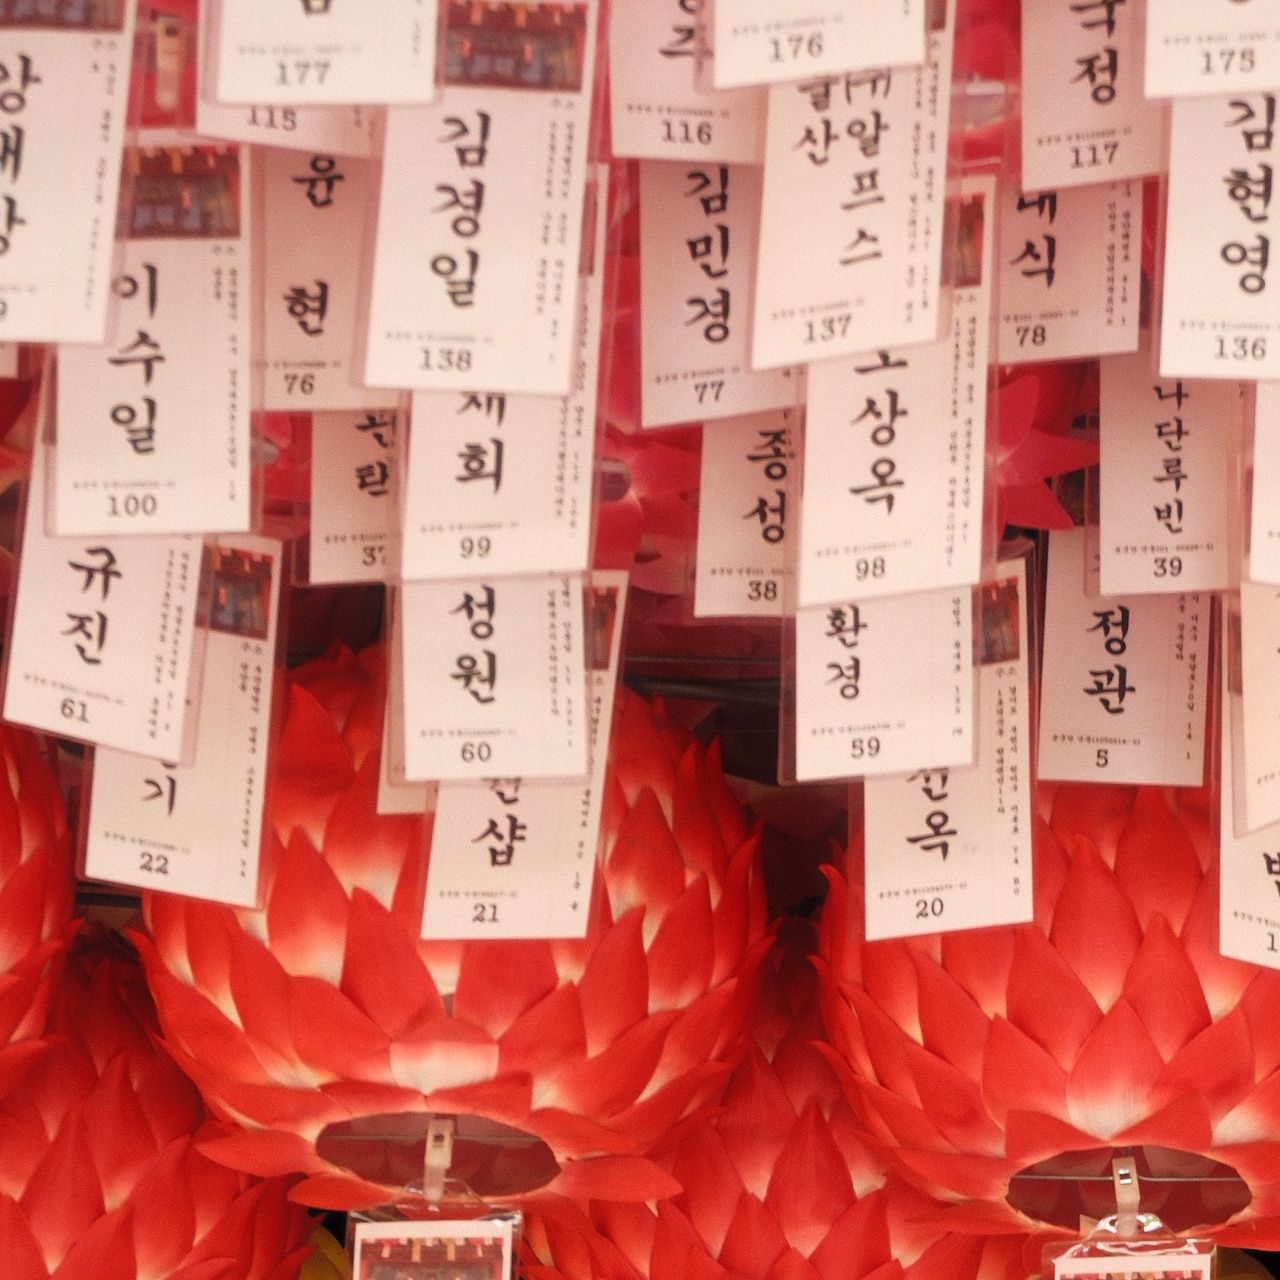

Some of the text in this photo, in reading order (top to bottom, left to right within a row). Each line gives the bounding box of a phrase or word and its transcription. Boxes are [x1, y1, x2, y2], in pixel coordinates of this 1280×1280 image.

[769, 34, 824, 63] 176
[276, 61, 331, 86] 177
[1202, 49, 1255, 75] 175
[248, 104, 297, 132] 115
[661, 119, 713, 145] 116
[1071, 142, 1119, 169] 117
[803, 314, 853, 345] 137
[1016, 325, 1046, 347] 78
[110, 262, 166, 456] 이수일
[1214, 334, 1267, 360] 136
[420, 349, 472, 372] 138
[283, 373, 316, 396] 76
[693, 380, 724, 403] 77
[106, 494, 158, 517] 100
[459, 537, 492, 560] 99
[855, 556, 887, 581] 98
[1152, 556, 1184, 579] 39
[748, 579, 778, 602] 38
[60, 697, 90, 724] 61
[460, 742, 492, 764] 60
[850, 736, 881, 761] 59
[1095, 748, 1109, 768] 5
[138, 852, 170, 876] 22
[471, 901, 500, 924] 21
[915, 896, 945, 919] 20
